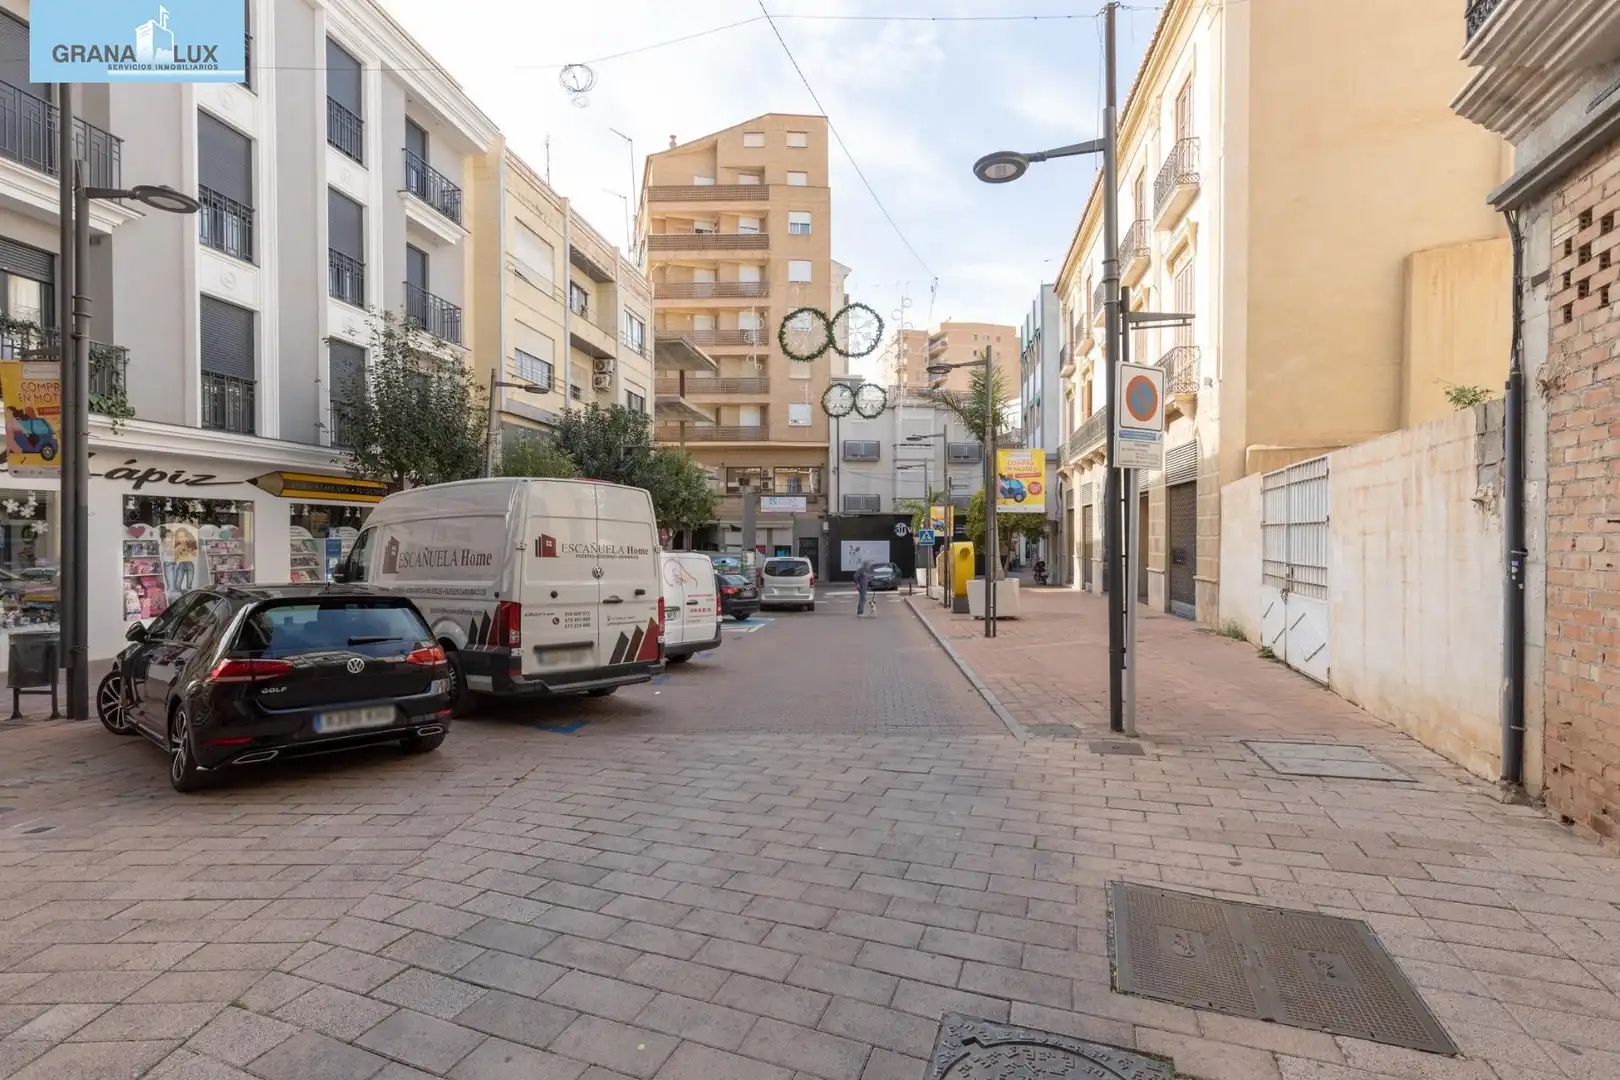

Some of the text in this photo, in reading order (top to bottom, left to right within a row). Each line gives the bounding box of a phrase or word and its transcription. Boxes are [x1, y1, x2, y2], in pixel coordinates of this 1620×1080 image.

[21, 381, 60, 393] COMPR
[17, 393, 60, 403] EN MOT
[88, 452, 245, 490] ápiz
[561, 542, 649, 556] ESCAÑUELA Home
[398, 547, 493, 569] ESCAÑUELA Home
[261, 686, 288, 694] GOLF
